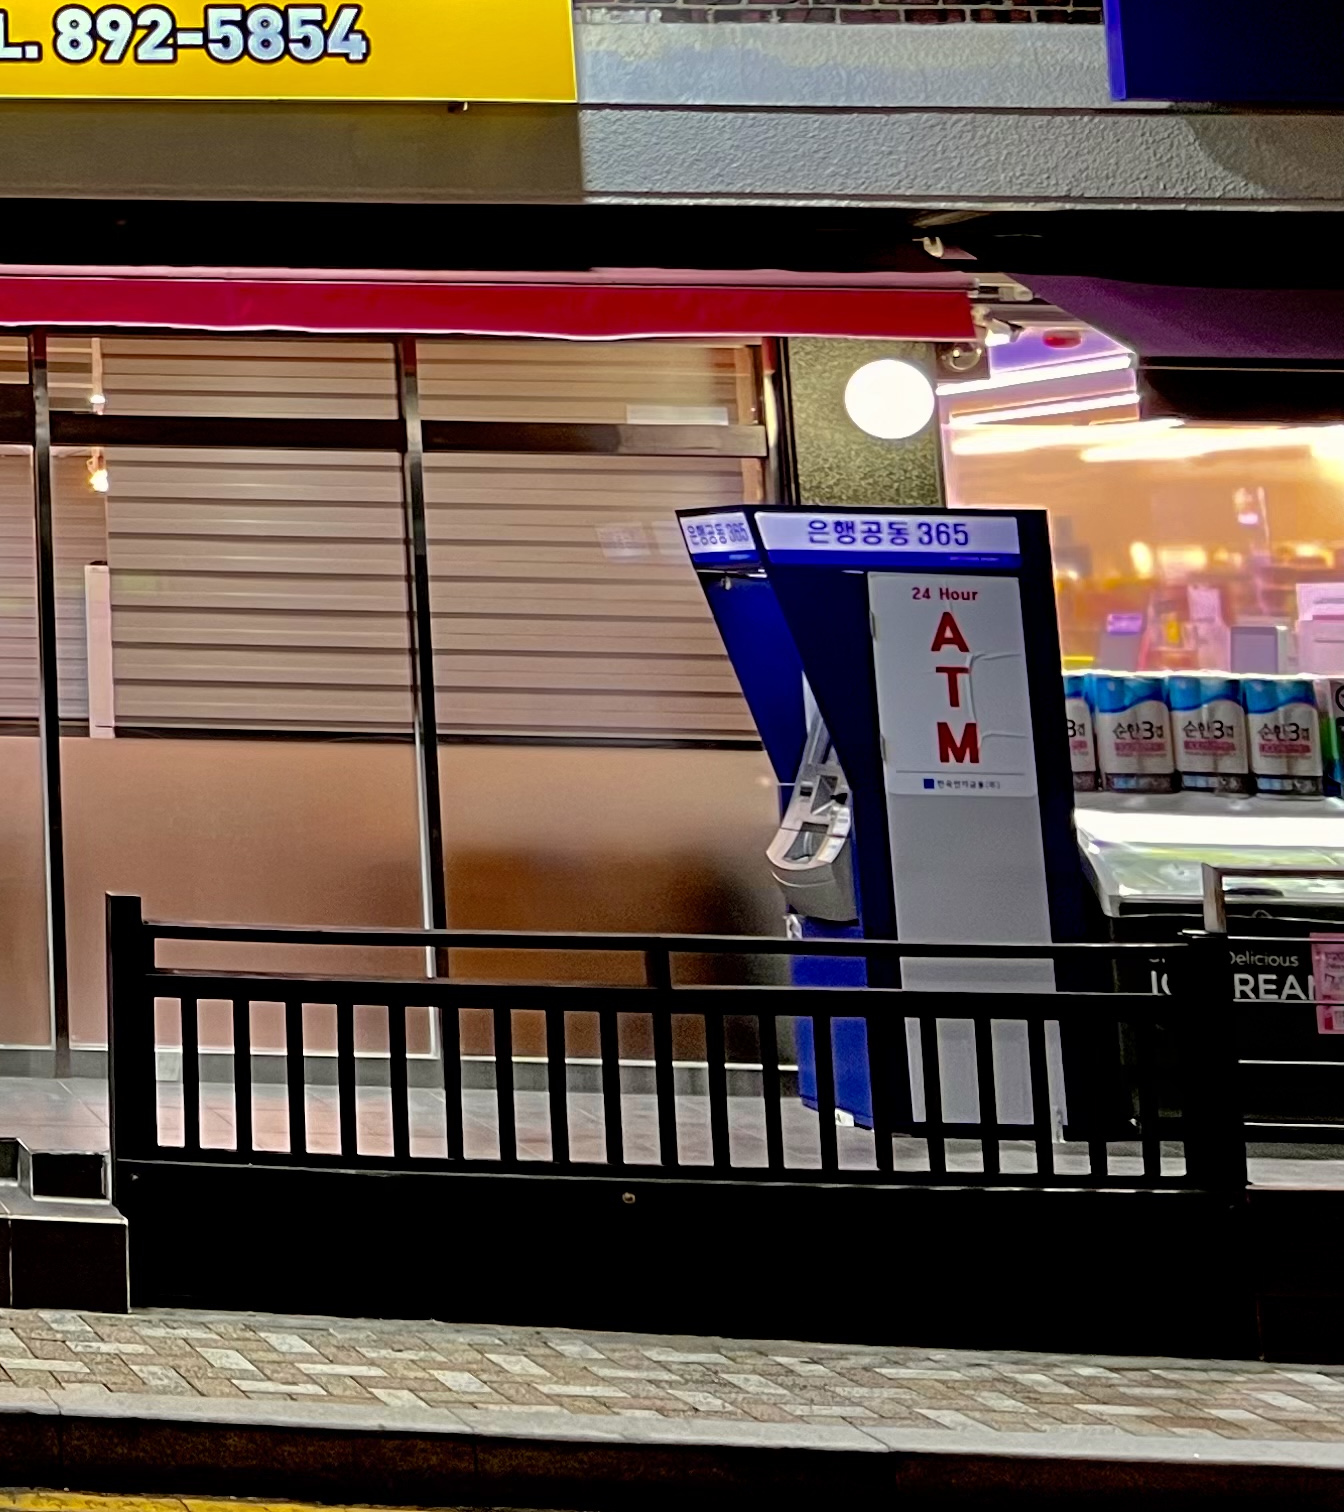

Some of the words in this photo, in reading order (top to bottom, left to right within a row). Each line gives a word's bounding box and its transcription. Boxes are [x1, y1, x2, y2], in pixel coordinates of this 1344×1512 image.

[54, 6, 368, 62] 892-5854
[912, 587, 931, 600] 24
[939, 587, 978, 601] Hour
[1233, 973, 1316, 1000] REA
